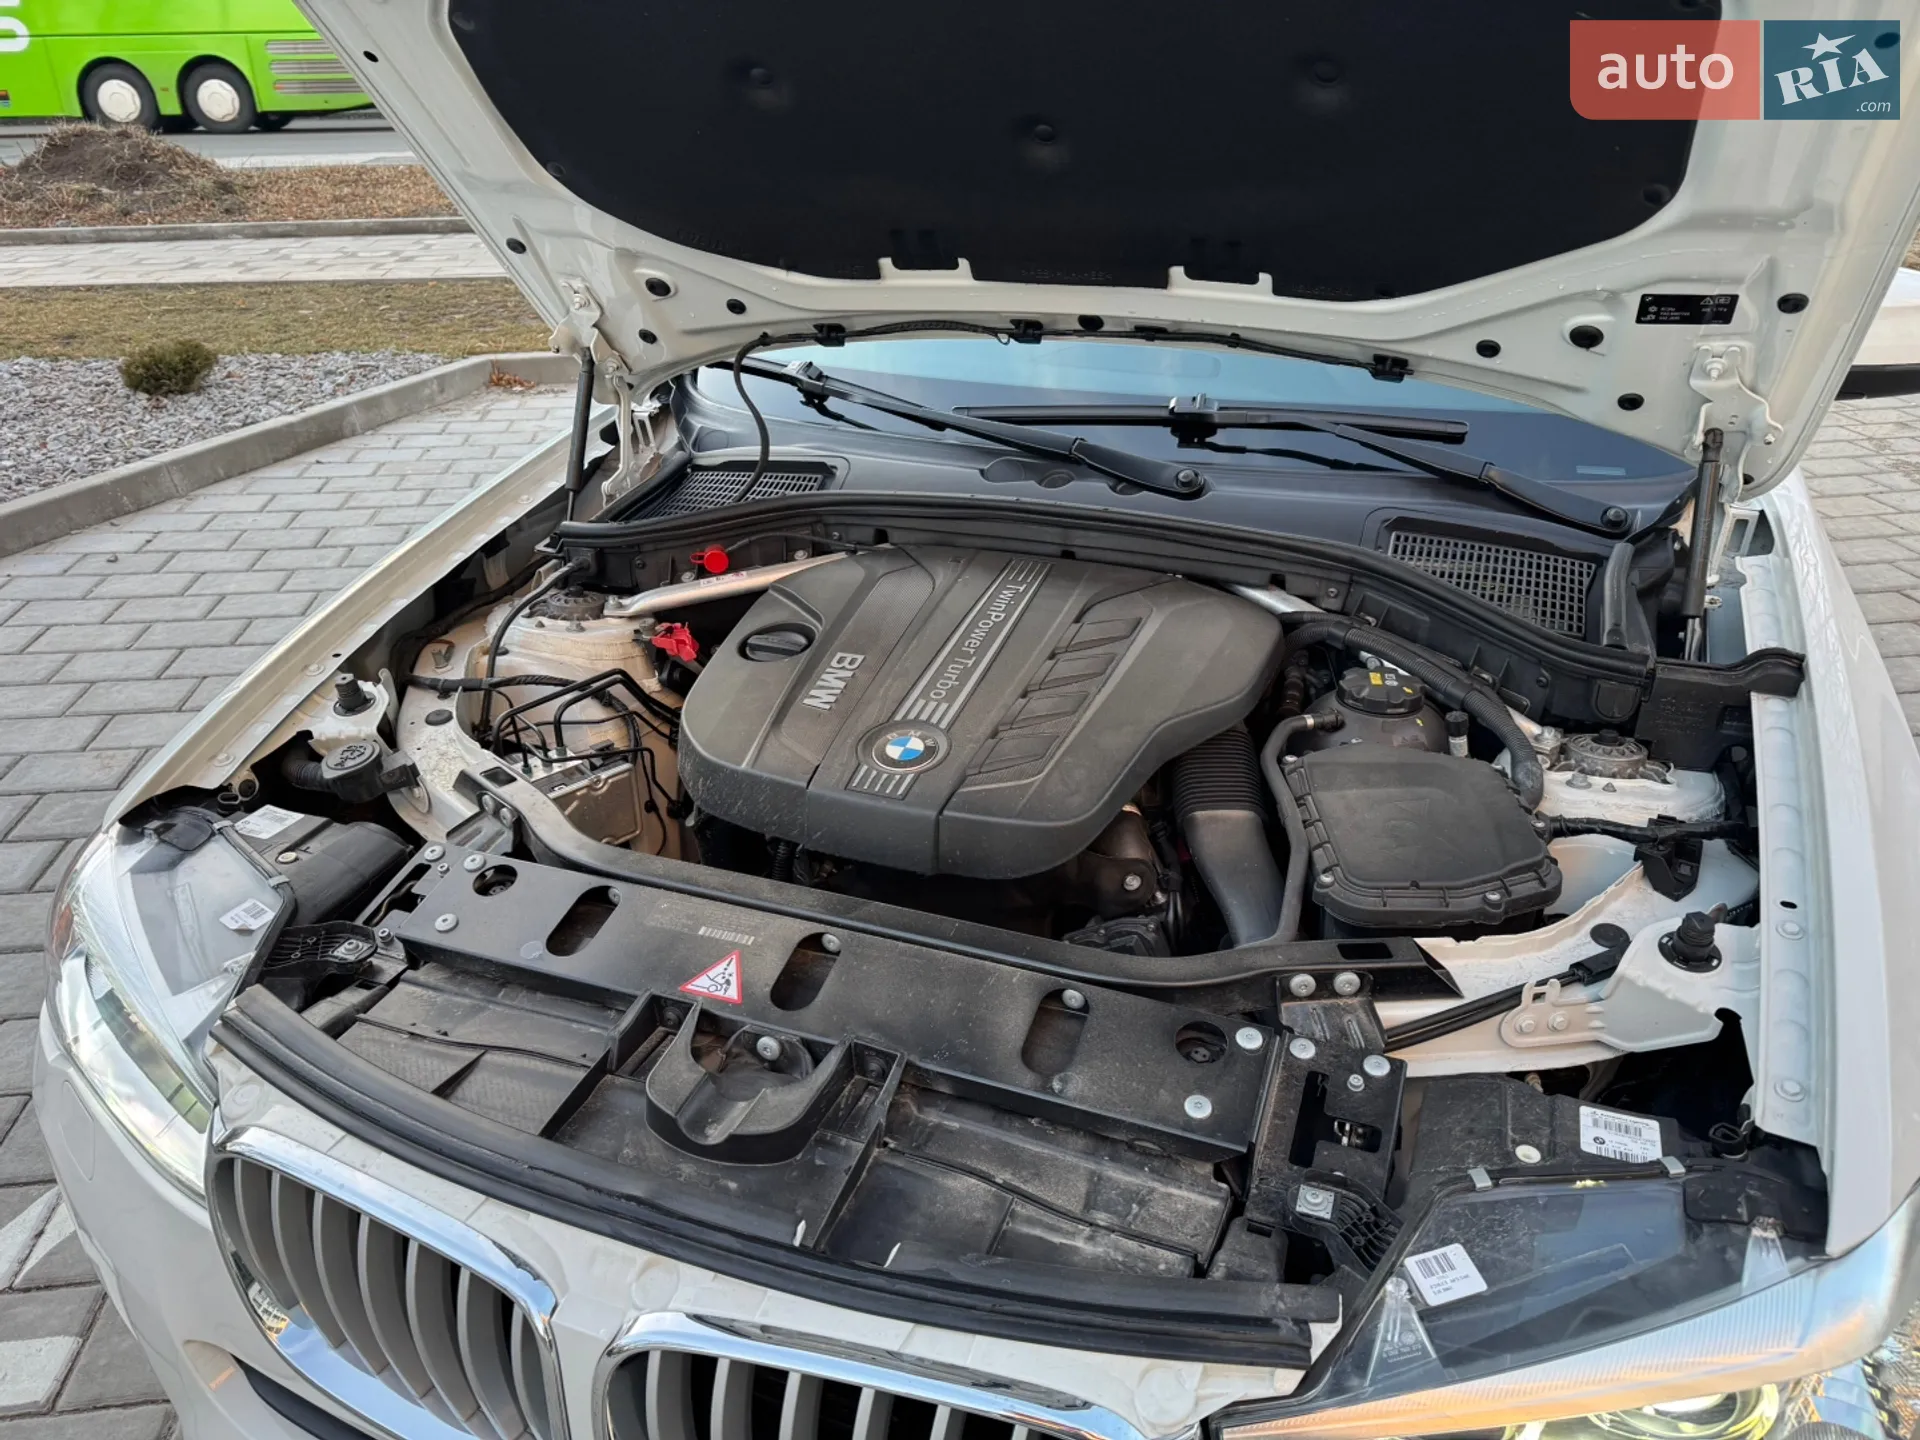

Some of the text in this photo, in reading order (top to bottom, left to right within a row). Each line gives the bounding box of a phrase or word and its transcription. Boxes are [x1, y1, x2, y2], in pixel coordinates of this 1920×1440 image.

[802, 652, 866, 711] BMW
[929, 583, 1027, 699] TwinPower Turbo
